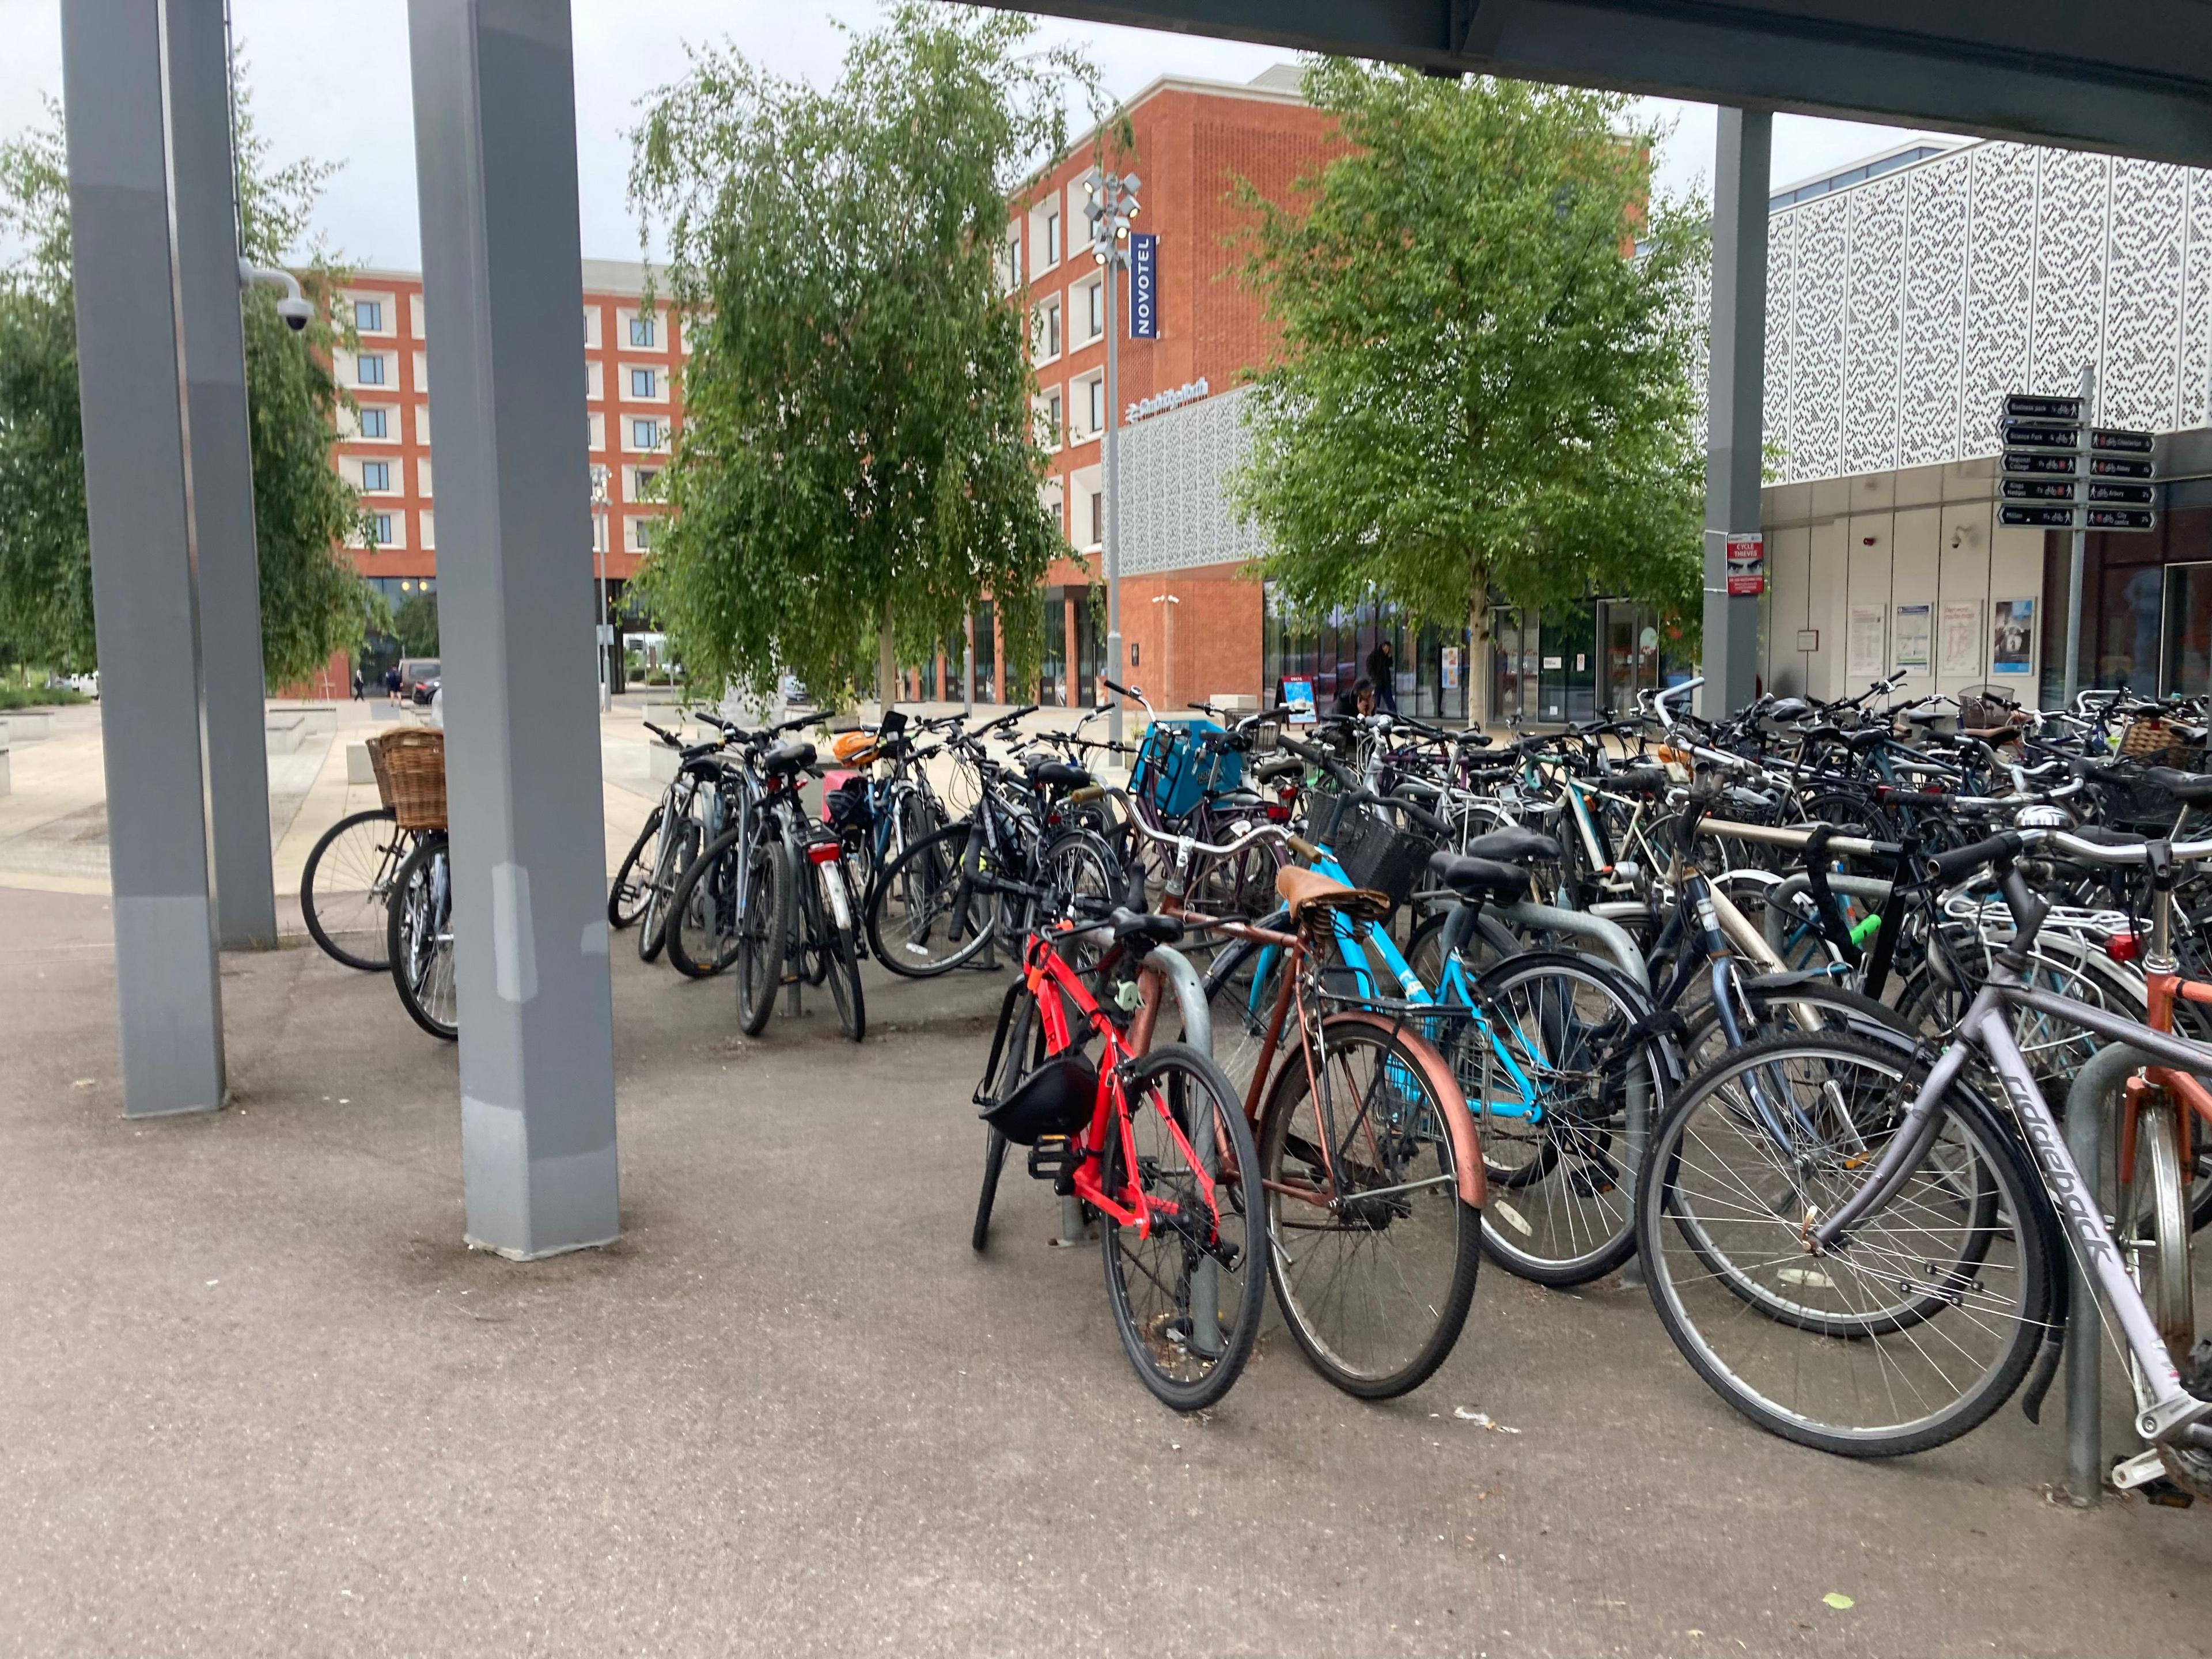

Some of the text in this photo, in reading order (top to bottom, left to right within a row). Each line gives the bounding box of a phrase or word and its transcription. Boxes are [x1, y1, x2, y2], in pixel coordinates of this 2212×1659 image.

[1138, 238, 1149, 334] NOVOTEL
[1140, 376, 1208, 415] Cambridge North
[2117, 512, 2127, 520] City
[1734, 550, 1758, 558] THIEVES
[2004, 1075, 2114, 1266] ridgeback
